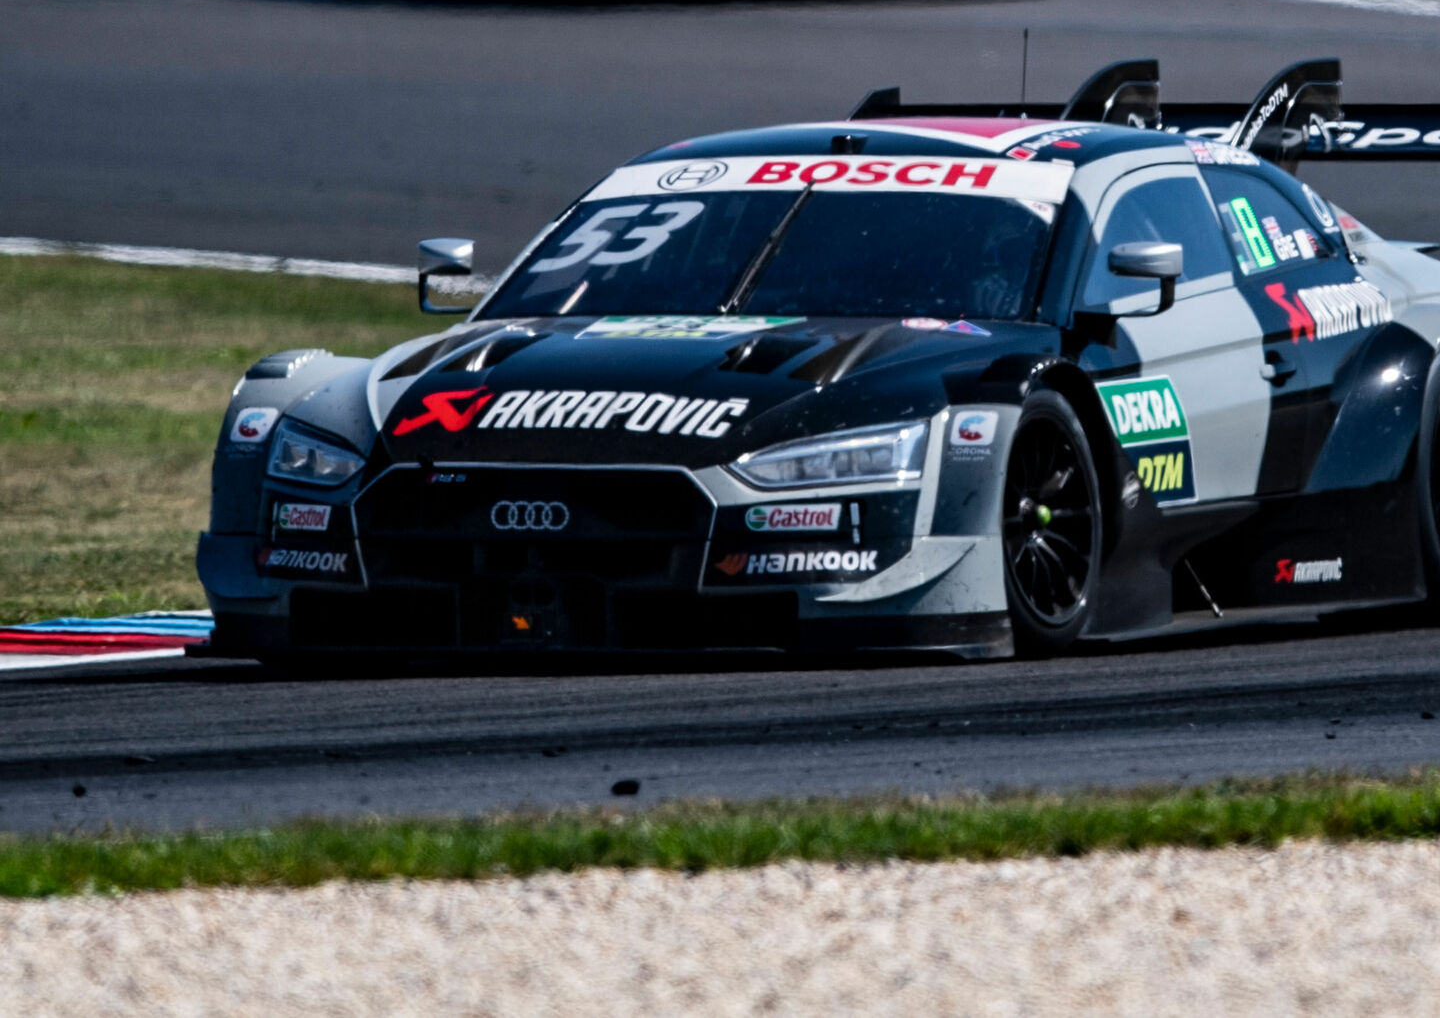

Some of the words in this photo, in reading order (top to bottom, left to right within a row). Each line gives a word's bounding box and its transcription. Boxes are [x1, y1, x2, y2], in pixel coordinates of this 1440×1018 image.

[746, 161, 998, 188] BOSCH
[528, 201, 705, 273] 53
[478, 390, 749, 438] AKRAPOVIČ
[1111, 388, 1181, 435] DEKRA
[1138, 452, 1184, 492] DTM
[289, 507, 328, 527] Castrol
[768, 508, 834, 529] Castrol
